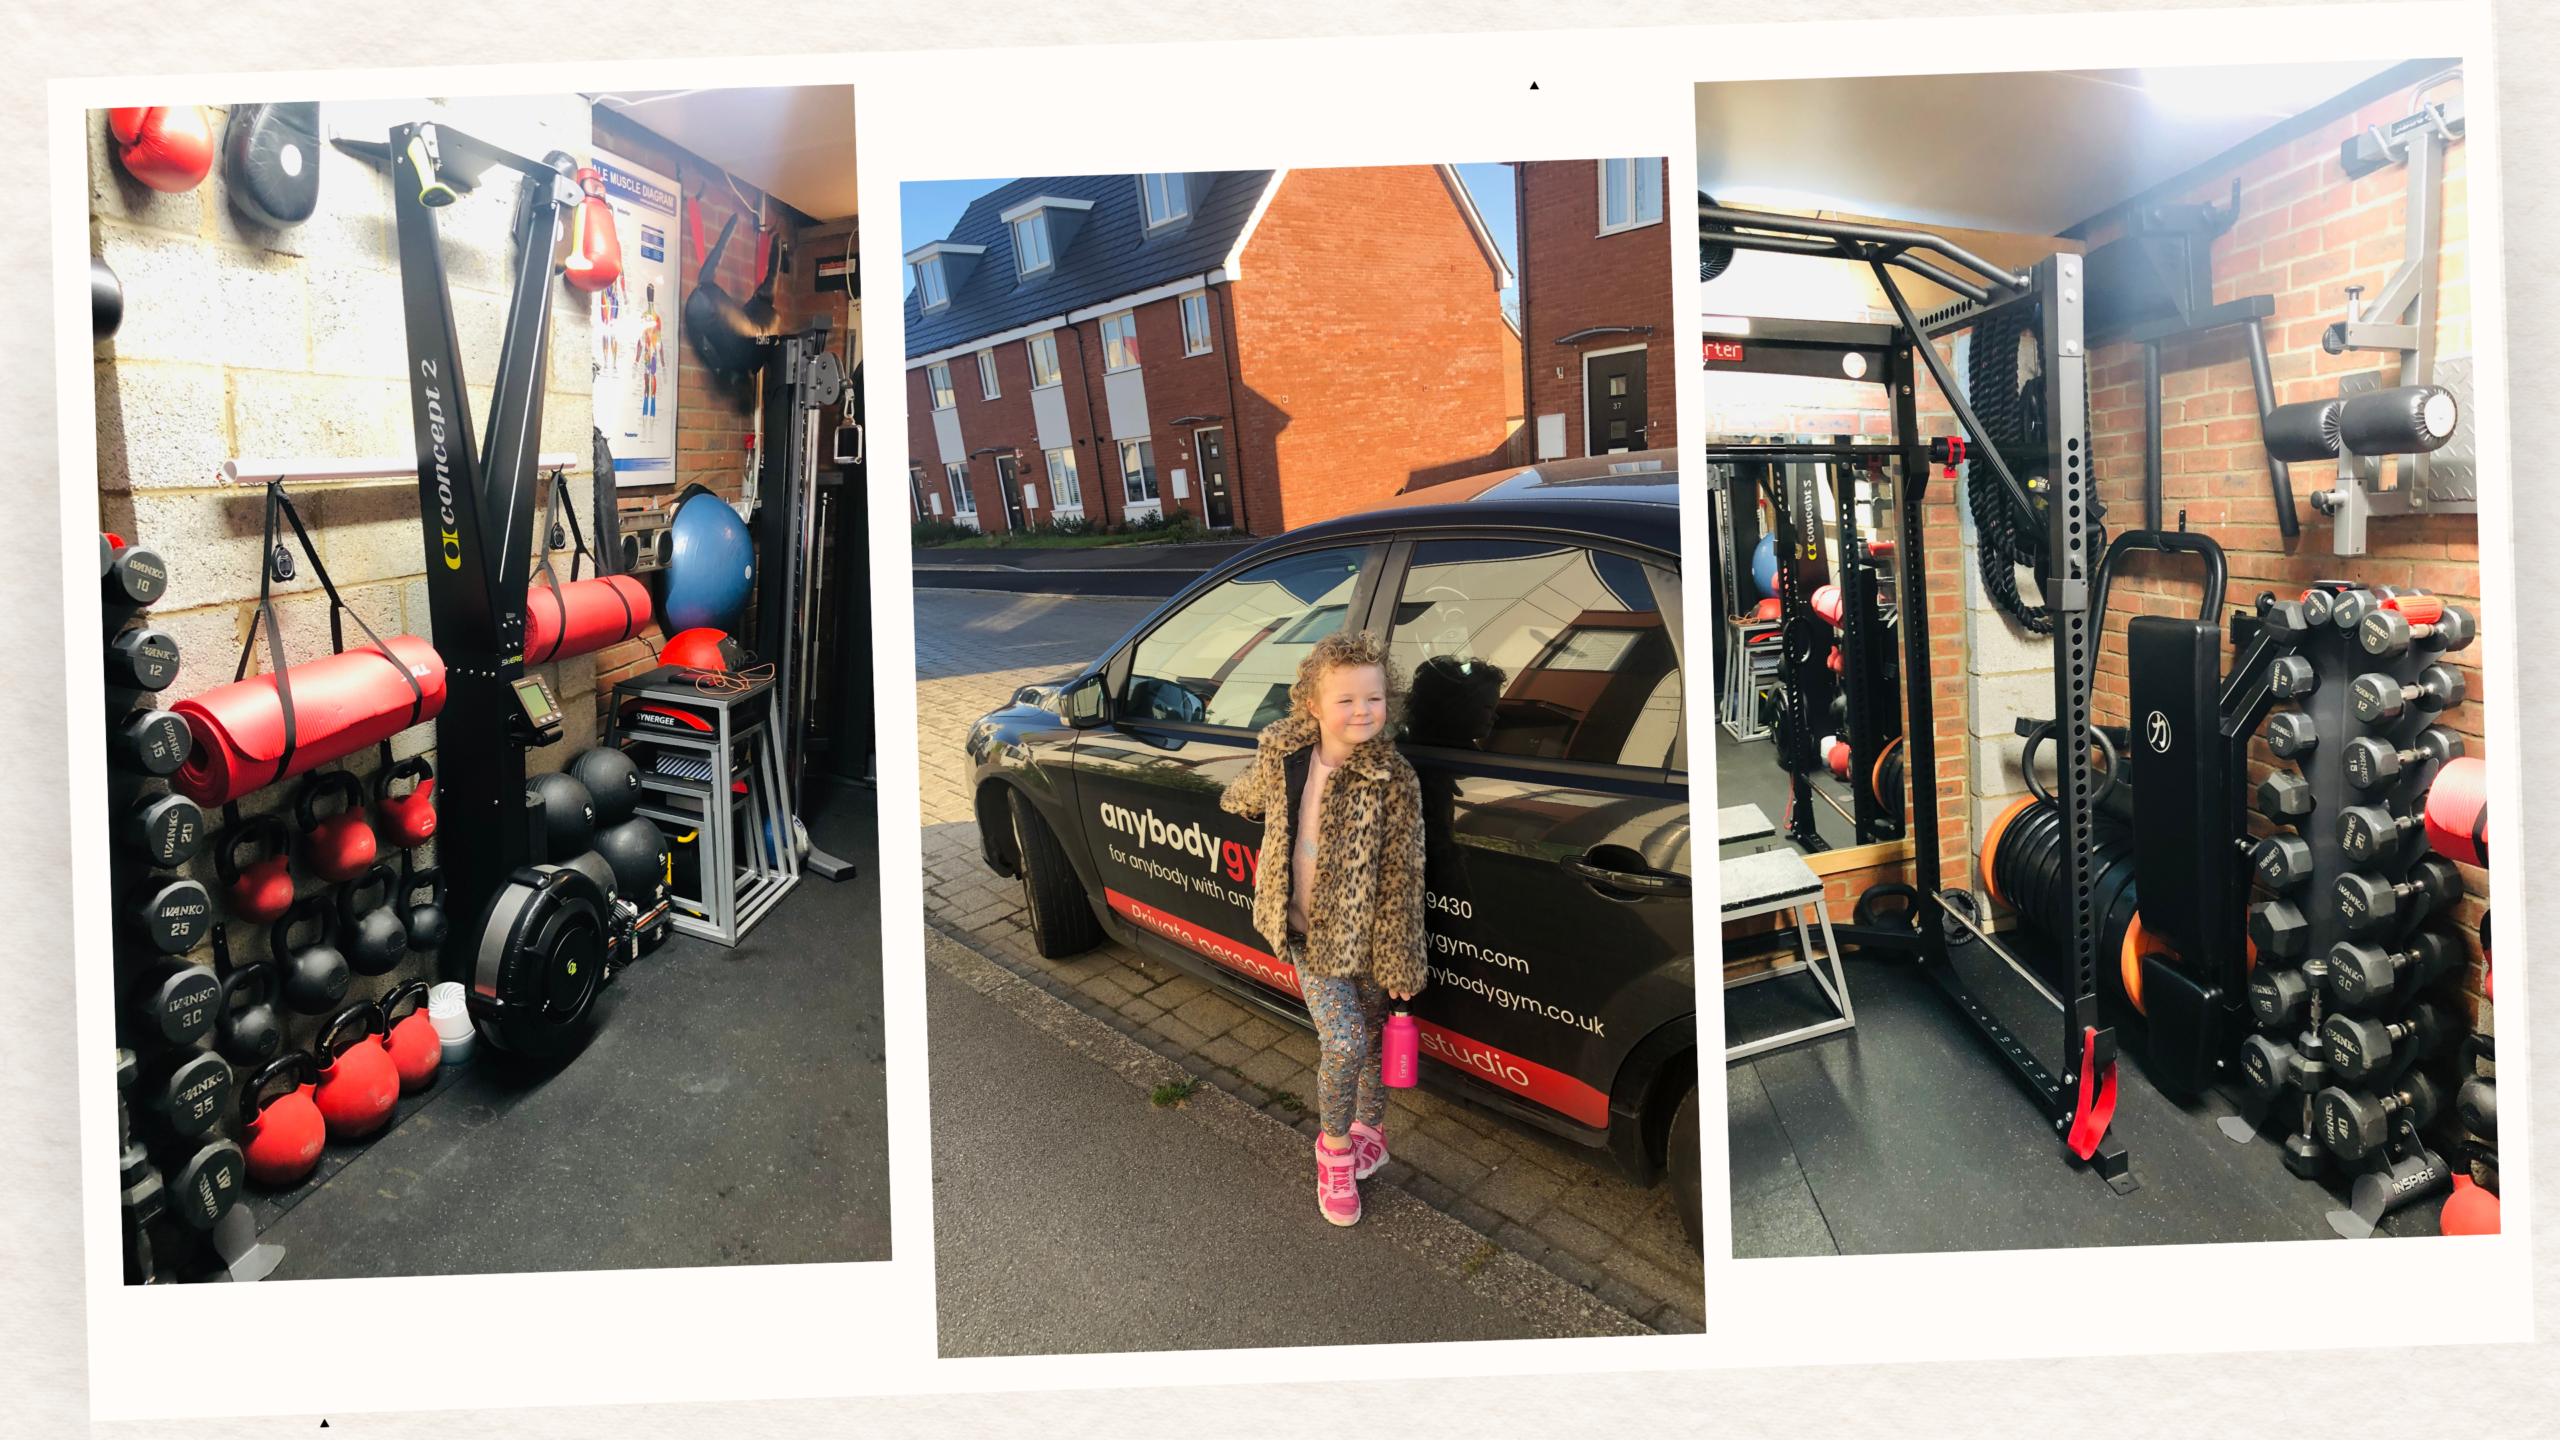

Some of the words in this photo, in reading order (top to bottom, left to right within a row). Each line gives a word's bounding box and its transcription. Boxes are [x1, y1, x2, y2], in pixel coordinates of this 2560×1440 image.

[593, 164, 608, 182] ALE
[610, 171, 641, 195] MUSCLE
[642, 185, 674, 209] DIAGRAM
[1704, 343, 1741, 358] rter
[421, 358, 438, 379] 2
[1613, 402, 1622, 410] 37
[425, 386, 455, 526] concept
[129, 559, 165, 580] IVANKO
[136, 578, 151, 593] 10
[2365, 618, 2389, 640] IVANKO
[2367, 634, 2378, 647] 10
[149, 664, 163, 677] 12
[2357, 700, 2368, 712] 12
[636, 713, 675, 726] SYNERGEE
[150, 741, 166, 758] 15
[163, 720, 183, 762] IVANKO
[2275, 736, 2284, 748] 15
[2349, 759, 2358, 772] 15
[164, 809, 179, 859] IVANKO
[180, 824, 194, 844] 20
[2343, 815, 2357, 850] IVANKO
[2355, 832, 2366, 850] 20
[1100, 802, 1260, 888] anybodygy
[2259, 846, 2280, 870] IVANKO
[1108, 844, 1126, 865] for
[1129, 856, 1188, 892] anybody
[1191, 876, 1225, 901] with
[2269, 862, 2281, 877] 25
[1426, 891, 1473, 919] 9430
[2338, 884, 2366, 912] IVANKO
[161, 904, 204, 918] IVANKO
[2341, 901, 2355, 918] 25
[170, 922, 190, 937] 25
[1131, 904, 1197, 948] Private
[1198, 933, 1299, 992] personal
[1425, 930, 1530, 974] ygym.com
[2332, 956, 2364, 982] IVANKO
[2338, 974, 2352, 991] 30
[168, 987, 216, 1013] IVANKO
[1427, 964, 1605, 1038] nybodygym.co.uk
[182, 1009, 202, 1028] 30
[1421, 1032, 1530, 1087] studio
[2334, 1048, 2349, 1067] 35
[2048, 1085, 2060, 1093] 18
[194, 1096, 214, 1120] 35
[2338, 1117, 2349, 1139] 40
[216, 1166, 232, 1190] 40
[2392, 1167, 2436, 1195] INSPIRE
